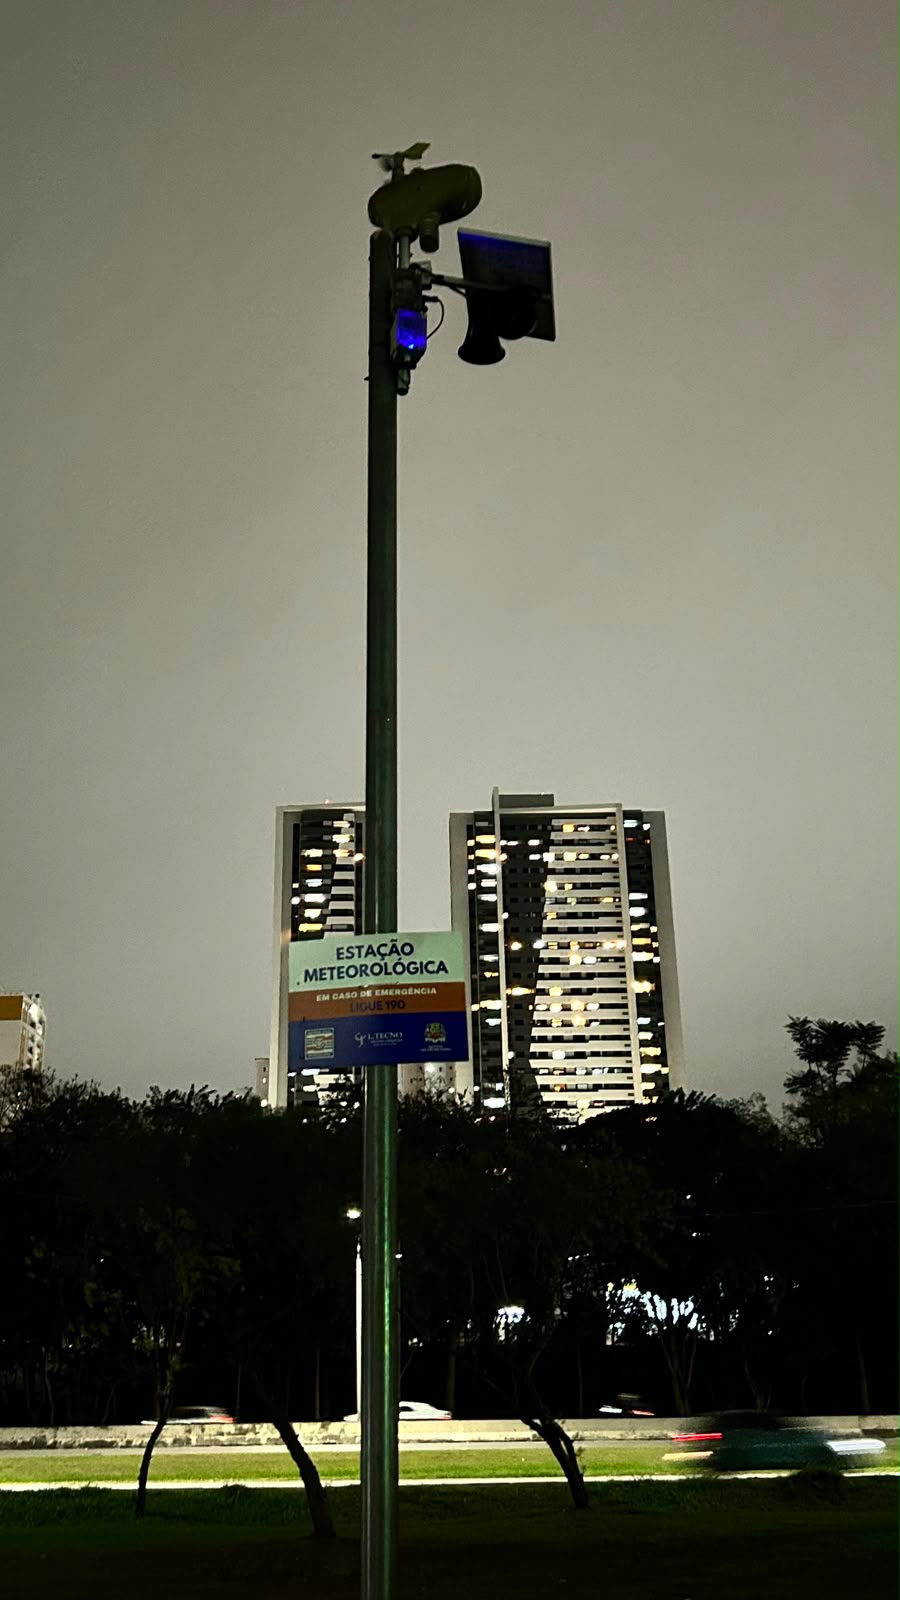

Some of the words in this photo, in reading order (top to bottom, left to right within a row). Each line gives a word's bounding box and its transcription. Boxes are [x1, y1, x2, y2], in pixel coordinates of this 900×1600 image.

[336, 939, 414, 961] ESTAÇÃO
[304, 958, 448, 983] METEOROLÓGICA
[316, 994, 330, 1002] EM
[332, 991, 358, 1000] CASO
[360, 990, 372, 998] DE
[375, 987, 437, 997] EMERGÊNCIA
[351, 1001, 384, 1012] LIGUE
[385, 1000, 406, 1011] 190
